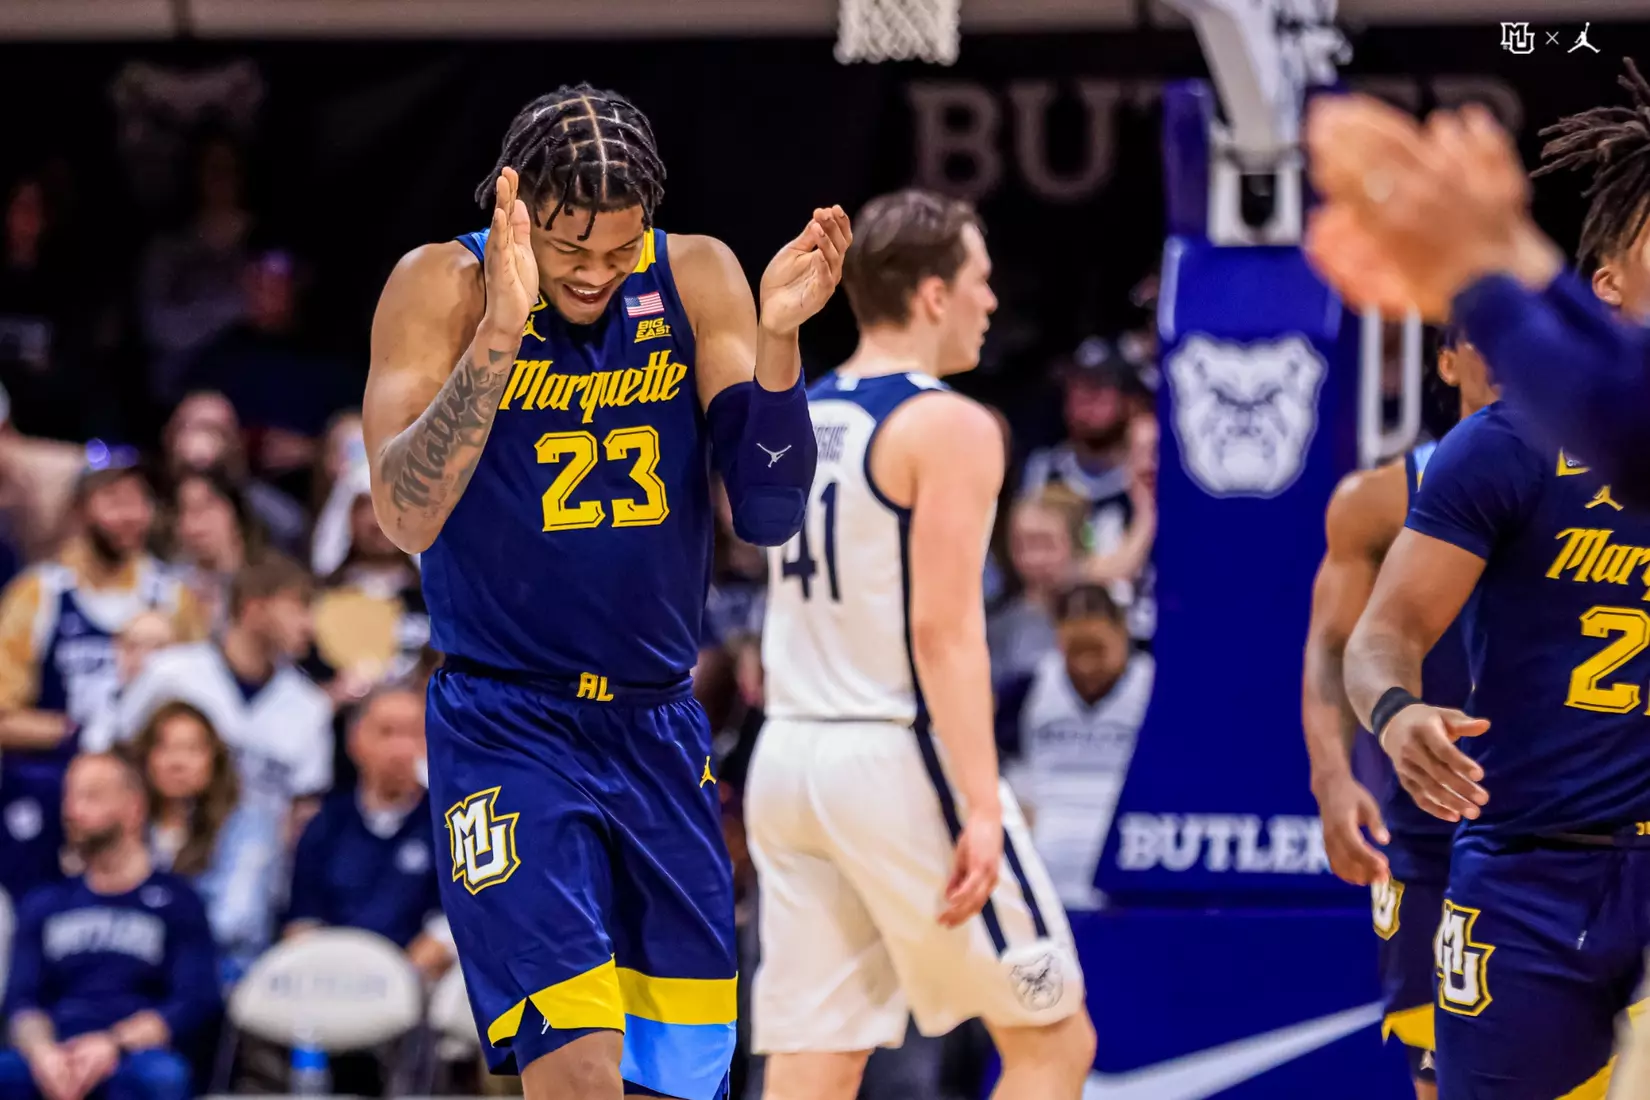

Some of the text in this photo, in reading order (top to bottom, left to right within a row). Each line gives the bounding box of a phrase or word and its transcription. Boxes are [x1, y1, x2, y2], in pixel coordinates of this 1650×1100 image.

[636, 325, 671, 339] EAST
[637, 317, 664, 330] BIG
[498, 349, 688, 424] Marquette
[533, 425, 670, 532] 23
[576, 672, 614, 701] AL
[1563, 605, 1650, 716] 2
[446, 788, 519, 893] MU
[1434, 901, 1492, 1014] MU
